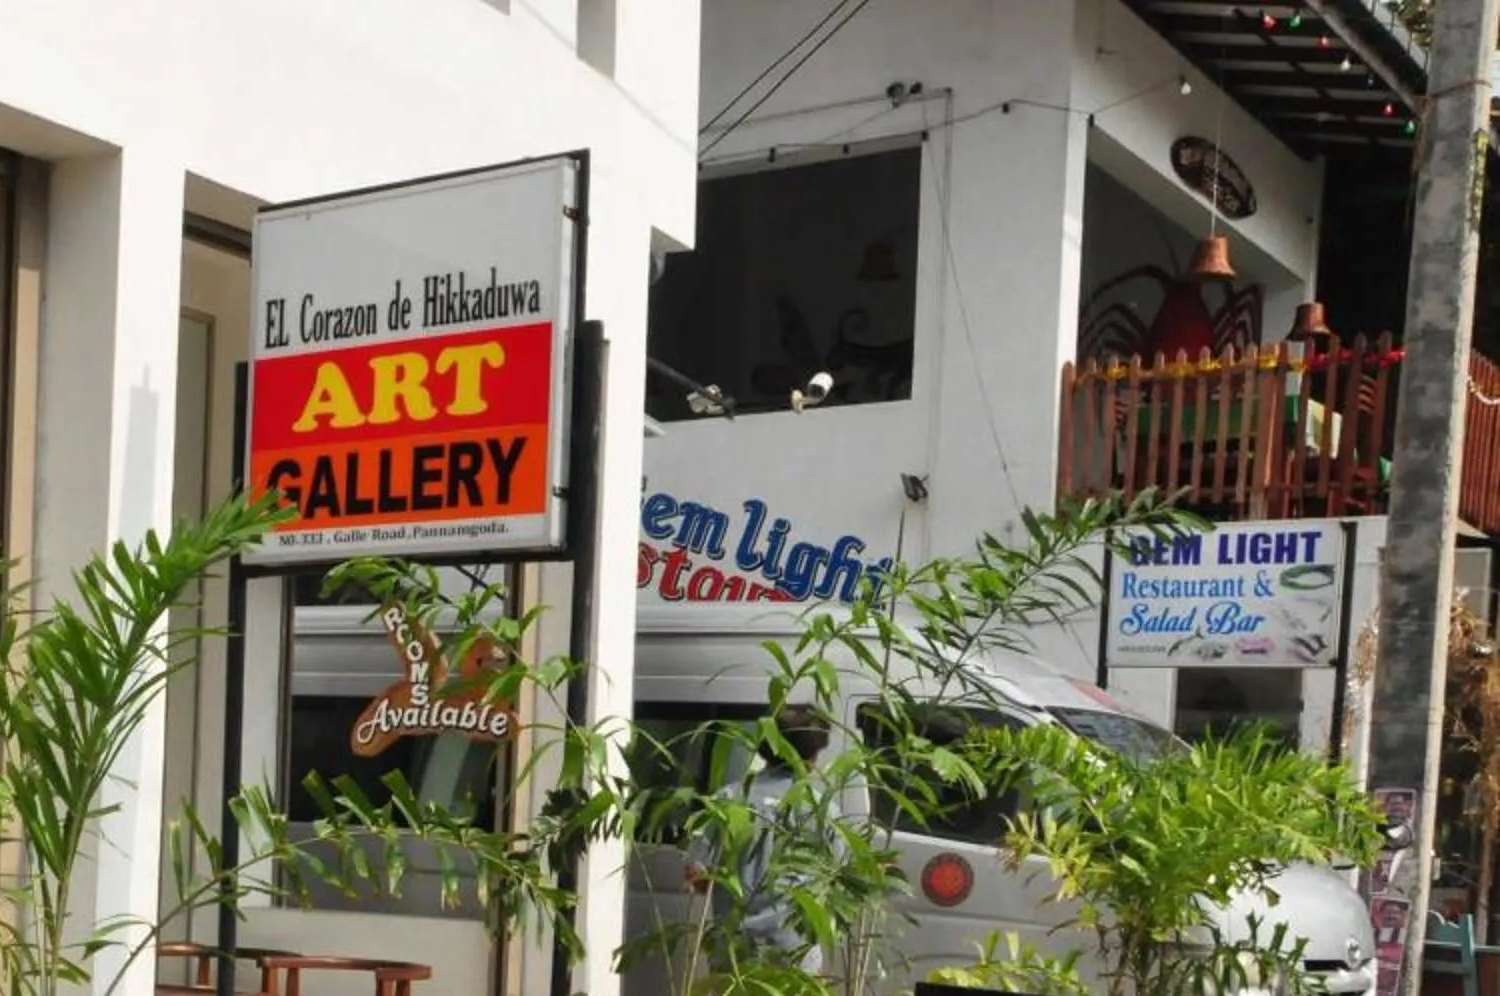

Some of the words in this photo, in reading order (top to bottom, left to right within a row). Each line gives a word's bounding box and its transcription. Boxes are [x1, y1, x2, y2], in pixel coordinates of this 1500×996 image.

[265, 299, 289, 349] EL
[299, 294, 377, 342] Corazon
[388, 280, 411, 331] de
[422, 266, 541, 328] Hikkaduwa
[291, 340, 505, 433] ART
[266, 436, 528, 519] GALLERY
[333, 528, 367, 544] Galle
[640, 491, 729, 560] em
[1129, 534, 1202, 567] GEM
[1217, 532, 1322, 565] LIGHT
[1122, 572, 1244, 600] Restaurant
[1253, 570, 1275, 598] &
[1119, 603, 1197, 636] Salad
[1205, 601, 1266, 635] Bar
[356, 699, 508, 744] Available
